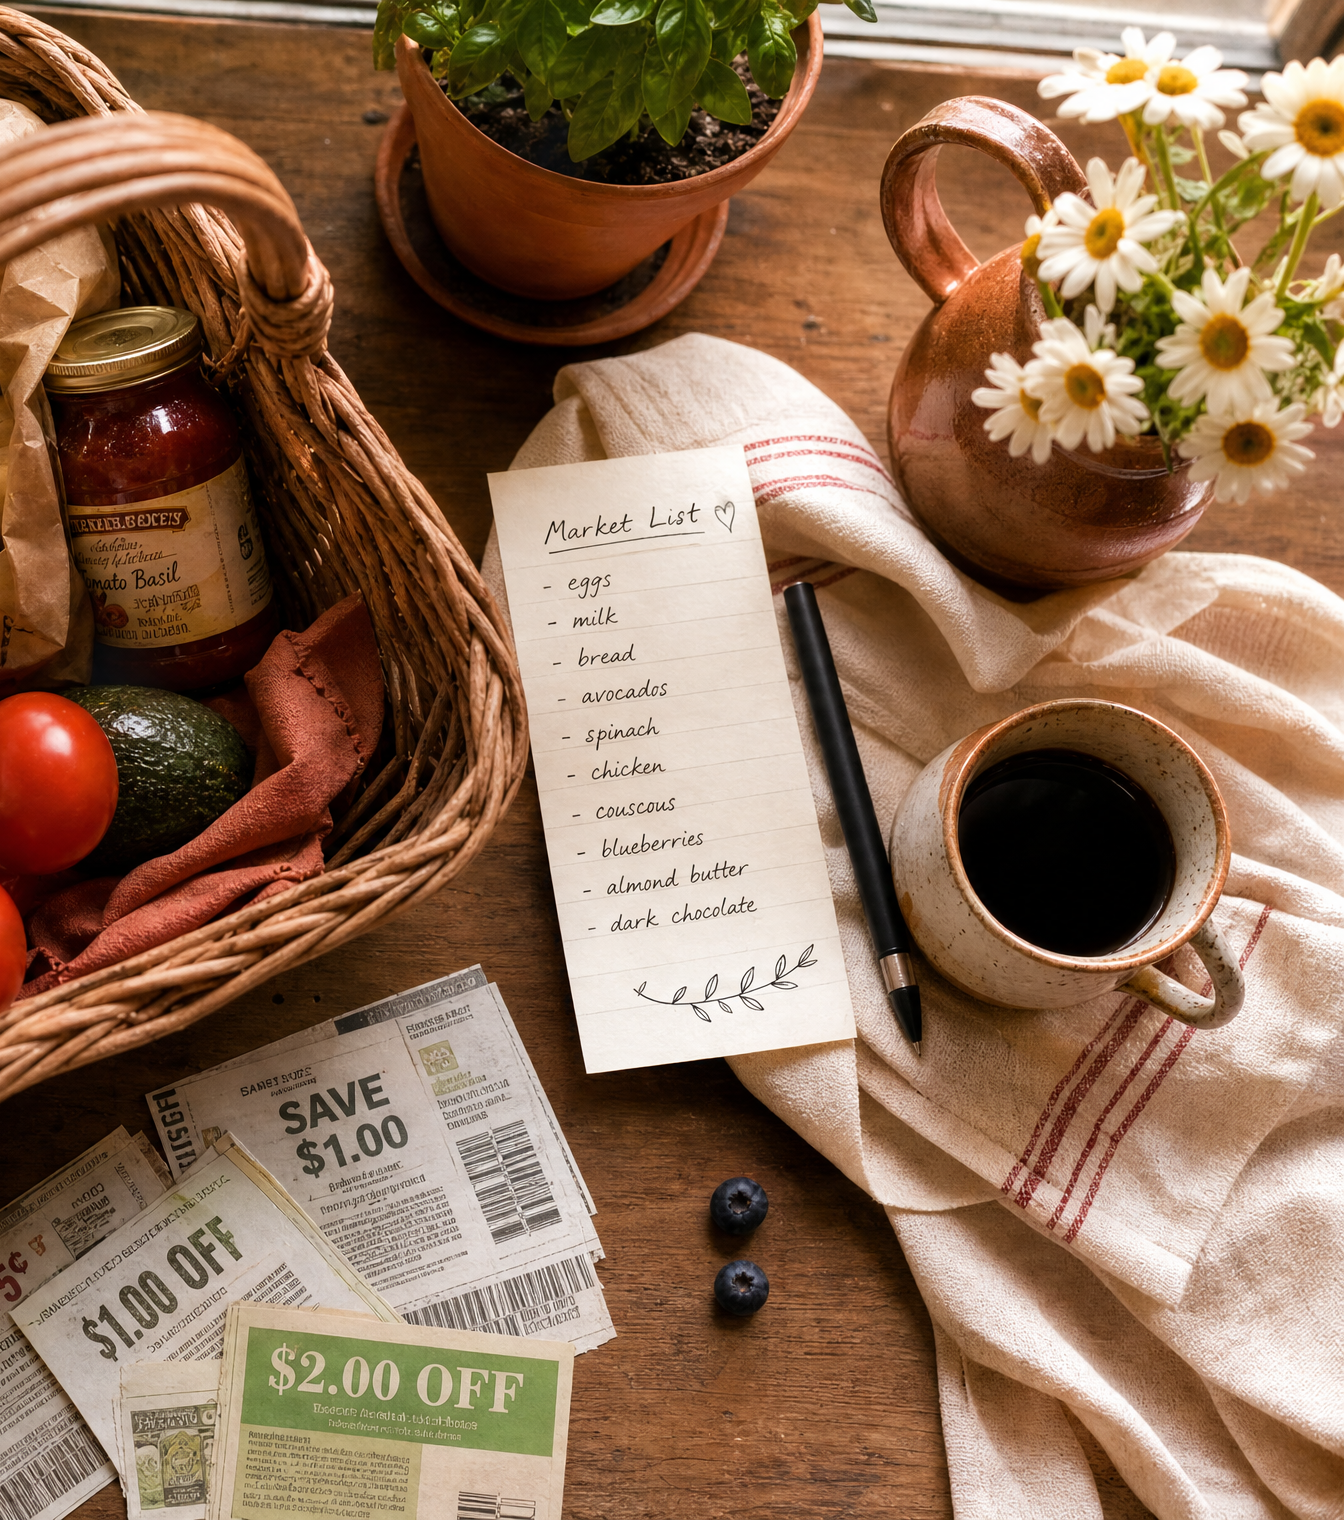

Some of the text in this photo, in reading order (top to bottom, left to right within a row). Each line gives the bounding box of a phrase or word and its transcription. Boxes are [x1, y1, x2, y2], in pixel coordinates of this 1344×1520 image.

[544, 502, 700, 545] Market List
[131, 561, 181, 590] Basil
[568, 572, 612, 598] eggs
[572, 607, 618, 628] milk
[578, 645, 636, 668] bread
[582, 680, 668, 704] avocados
[586, 718, 660, 749] spinach
[591, 757, 666, 781] chicken
[596, 795, 676, 820] couscous
[602, 830, 704, 858] blueberries
[606, 860, 748, 895] almond butter
[610, 896, 758, 933] dark chocolate
[279, 1072, 390, 1135] SAVE
[296, 1114, 409, 1178] $1.00
[81, 1270, 178, 1362] $1.00
[166, 1215, 243, 1290] OFF
[268, 1342, 524, 1413] $2.00 OFF
